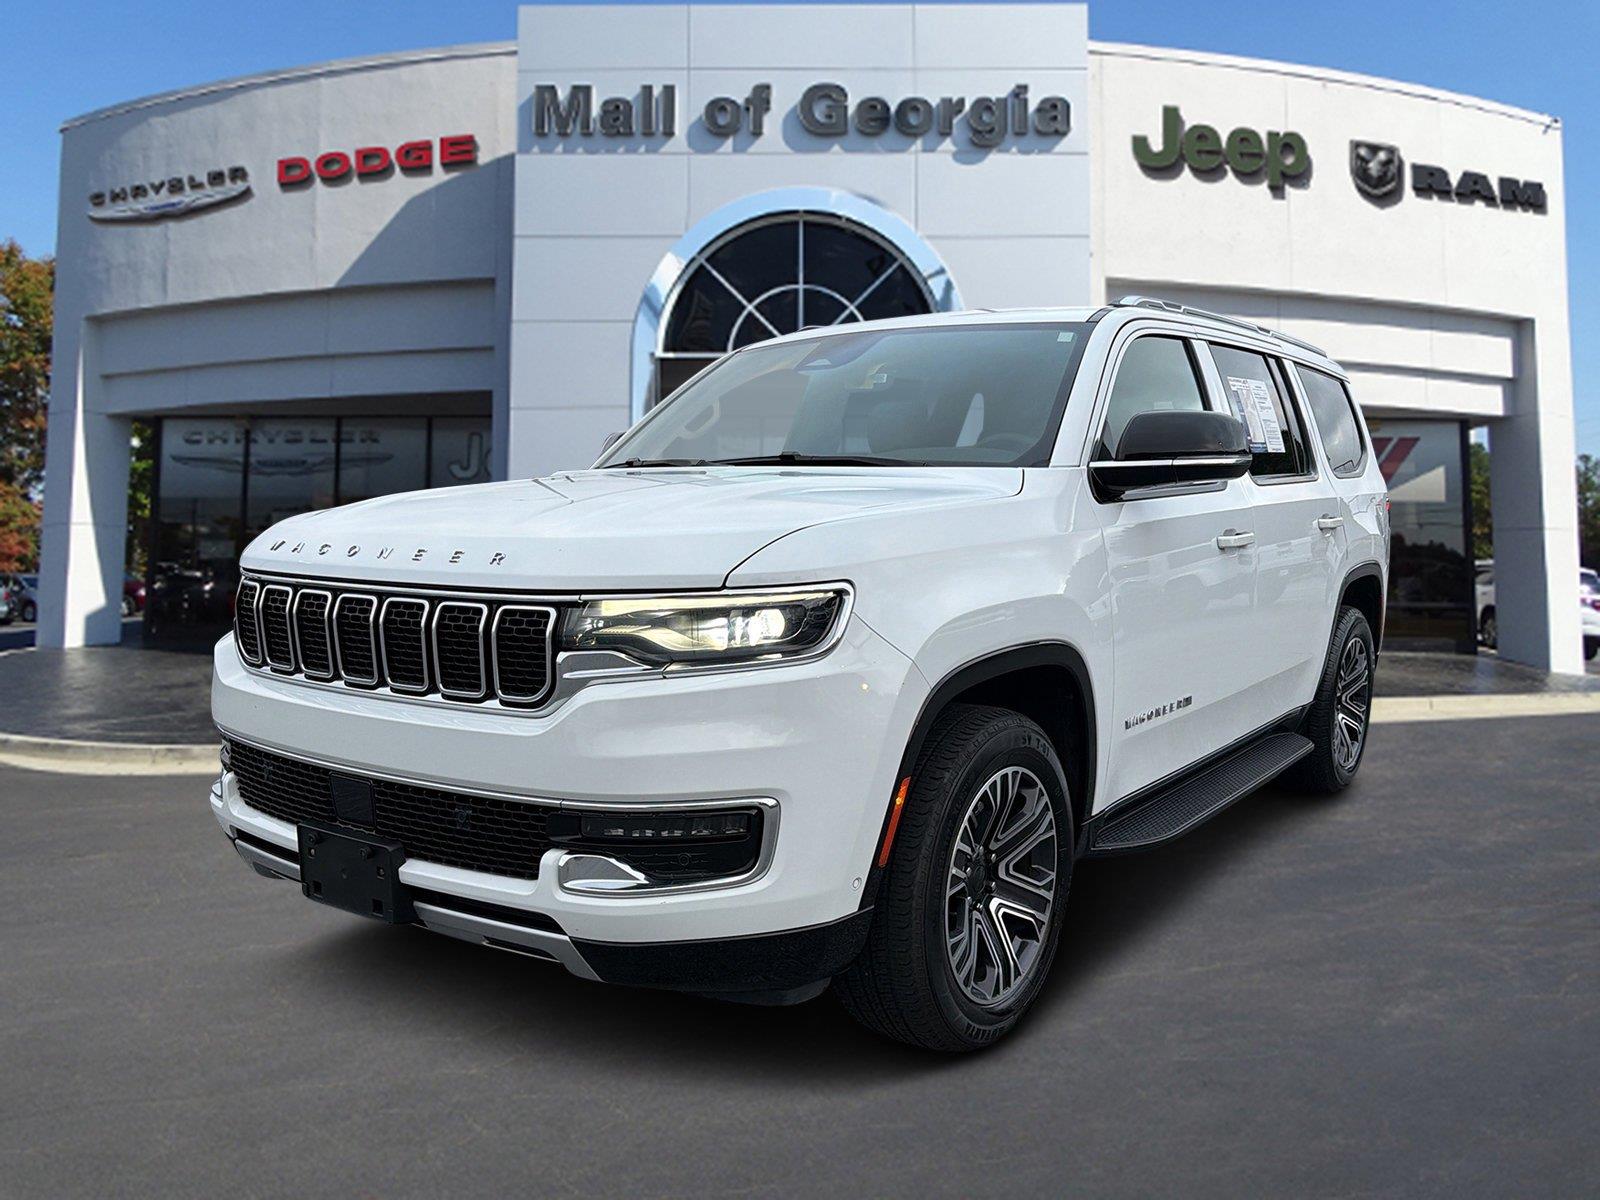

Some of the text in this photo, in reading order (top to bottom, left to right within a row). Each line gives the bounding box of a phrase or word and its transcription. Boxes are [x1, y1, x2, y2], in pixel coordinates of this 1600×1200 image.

[533, 82, 1072, 148] Mall of Georgia
[277, 134, 477, 188] DODGE
[1131, 105, 1310, 192] Jeep
[89, 166, 249, 207] CHRYSLER
[1411, 163, 1547, 214] RAM
[269, 539, 507, 566] WAGONEER
